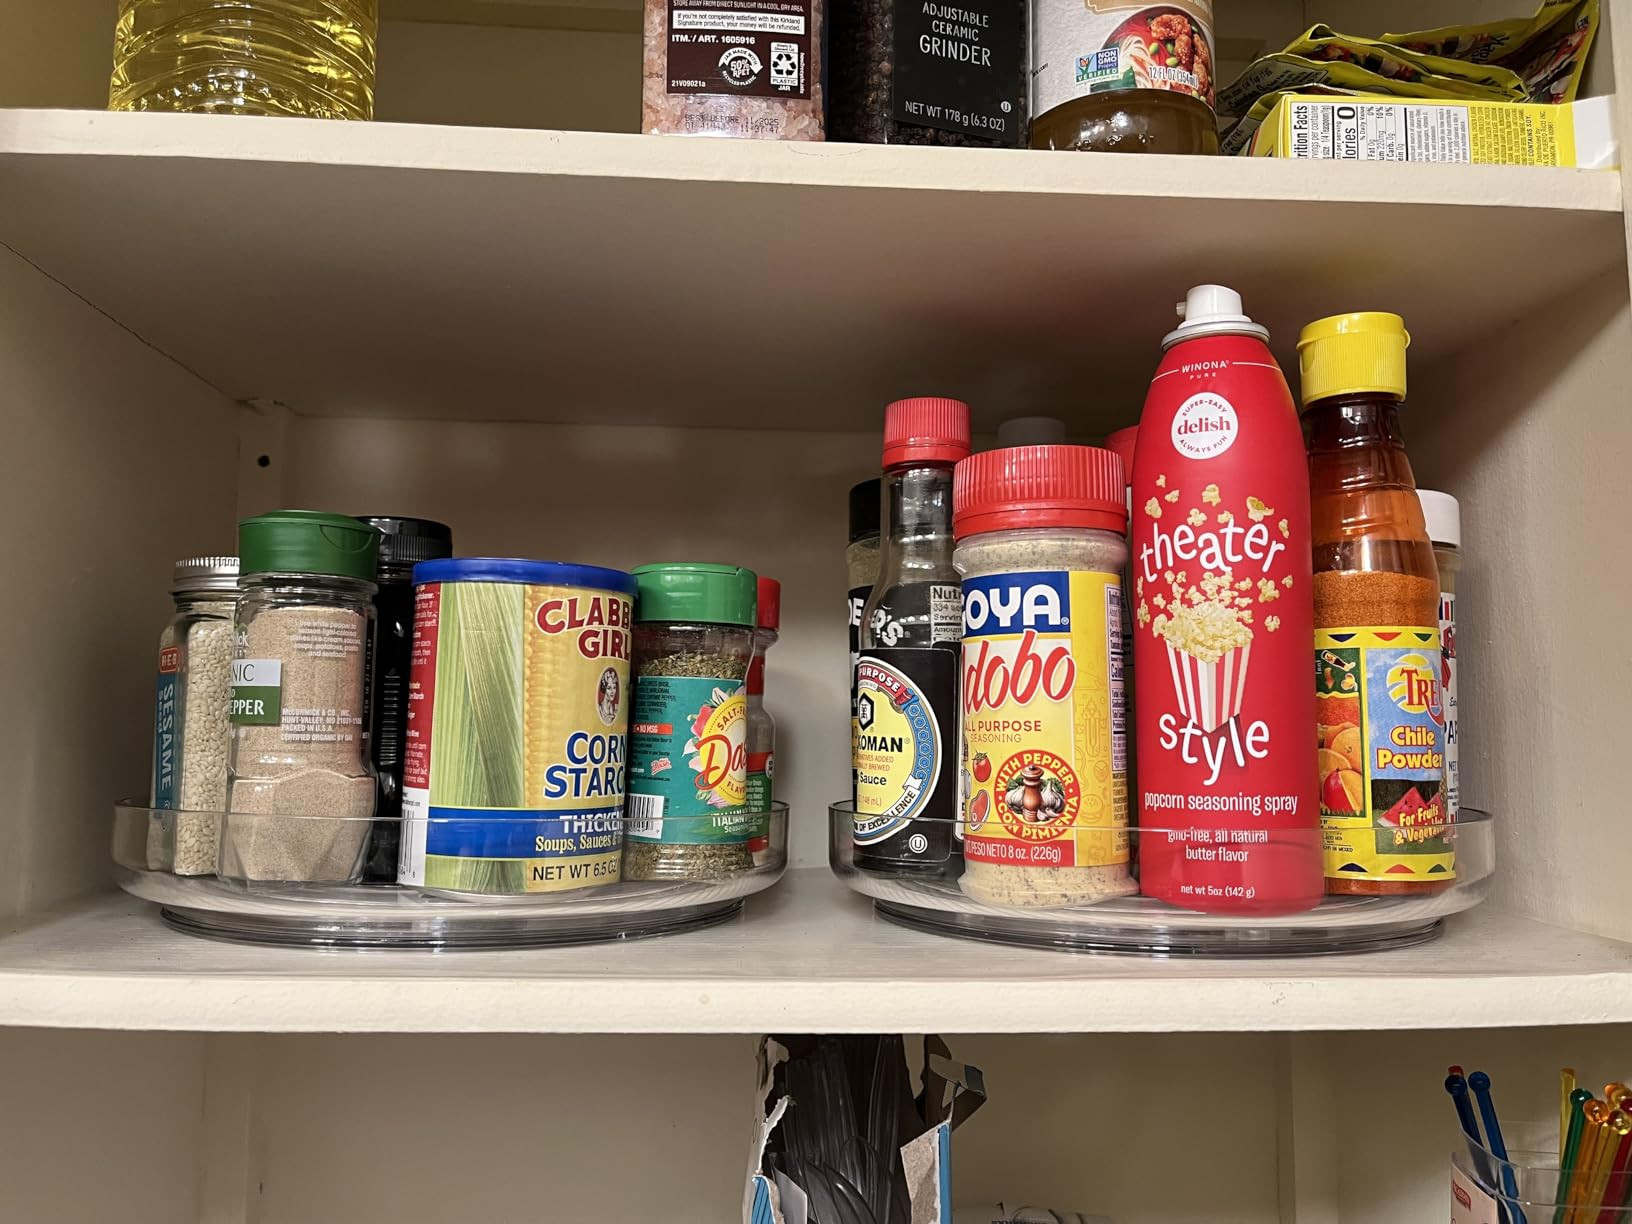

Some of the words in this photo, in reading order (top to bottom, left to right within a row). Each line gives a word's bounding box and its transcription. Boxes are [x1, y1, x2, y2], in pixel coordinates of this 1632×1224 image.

[922, 1, 989, 28] ADJUSTABLE
[699, 35, 719, 44] ART.
[720, 35, 756, 45] 1605916
[931, 20, 979, 42] CERAMIC
[919, 34, 991, 67] GRINDER
[731, 59, 749, 71] 50%
[1097, 56, 1118, 64] GMO
[1077, 68, 1118, 82] VERIFIED
[1150, 66, 1158, 78] 12
[1159, 69, 1167, 80] FL
[1167, 70, 1177, 81] OZ
[904, 100, 925, 115] NET
[926, 105, 942, 119] WT
[945, 108, 960, 123] 178
[962, 114, 969, 127] g
[970, 112, 988, 128] (6.3
[989, 117, 1005, 132] OZ)
[1293, 105, 1308, 130] Facts
[1311, 105, 1320, 131] container
[1336, 106, 1356, 120] 0
[1367, 106, 1375, 117] 0%
[1376, 106, 1384, 119] 10%
[1386, 107, 1393, 118] 0%
[1539, 120, 1547, 132] RICO
[1312, 131, 1320, 141] per
[1525, 128, 1534, 157] CONTAINS
[1540, 132, 1548, 153] PUERTO
[1367, 147, 1375, 158] Fat
[1386, 141, 1394, 158] Carb.
[1535, 135, 1543, 163] Distributed
[1181, 360, 1228, 374] WINONA
[1189, 372, 1217, 380] PURE
[1182, 399, 1228, 417] SUPER-EASY
[1177, 416, 1231, 435] delish
[1179, 438, 1212, 453] ALWAYS
[1213, 435, 1229, 449] FUN
[1139, 516, 1286, 583] theater
[965, 583, 1061, 630] OYA
[578, 629, 631, 661] GIRL
[963, 629, 1076, 715] dobo
[977, 720, 1042, 732] PURPOSE
[161, 683, 175, 791] SESAME
[970, 733, 1022, 744] SEASONING
[1389, 725, 1435, 750] Chile
[1158, 712, 1270, 786] style
[869, 763, 891, 772] BREWED
[875, 755, 894, 763] ADDED
[860, 771, 887, 786] Sauce
[995, 759, 1021, 793] WITH
[1022, 753, 1073, 786] PEPPER
[1144, 792, 1185, 811] popcorn
[1186, 792, 1262, 816] seasoning
[1263, 795, 1298, 815] spray
[997, 803, 1018, 834] CON
[1020, 796, 1079, 839] PIMIENTA
[1399, 812, 1415, 827] For
[1417, 803, 1439, 823] Fruits
[536, 836, 577, 854] Soups,
[579, 833, 612, 850] Sauces
[1167, 827, 1213, 843] gmo-free,
[1215, 829, 1229, 842] all
[1230, 829, 1268, 843] natural
[1395, 829, 1405, 845] &
[986, 842, 1007, 858] NETO
[1008, 845, 1014, 859] 8
[1015, 847, 1029, 860] oz.
[1029, 845, 1063, 863] (226g)
[1185, 845, 1217, 861] butter
[1217, 846, 1249, 862] flavor
[532, 865, 565, 881] NET
[569, 863, 591, 879] WT
[593, 861, 607, 877] 6.5
[1180, 883, 1194, 895] net
[1194, 884, 1206, 895] wt
[1207, 884, 1223, 896] 5oz
[1224, 885, 1244, 897] (142
[1245, 886, 1256, 899] g)
